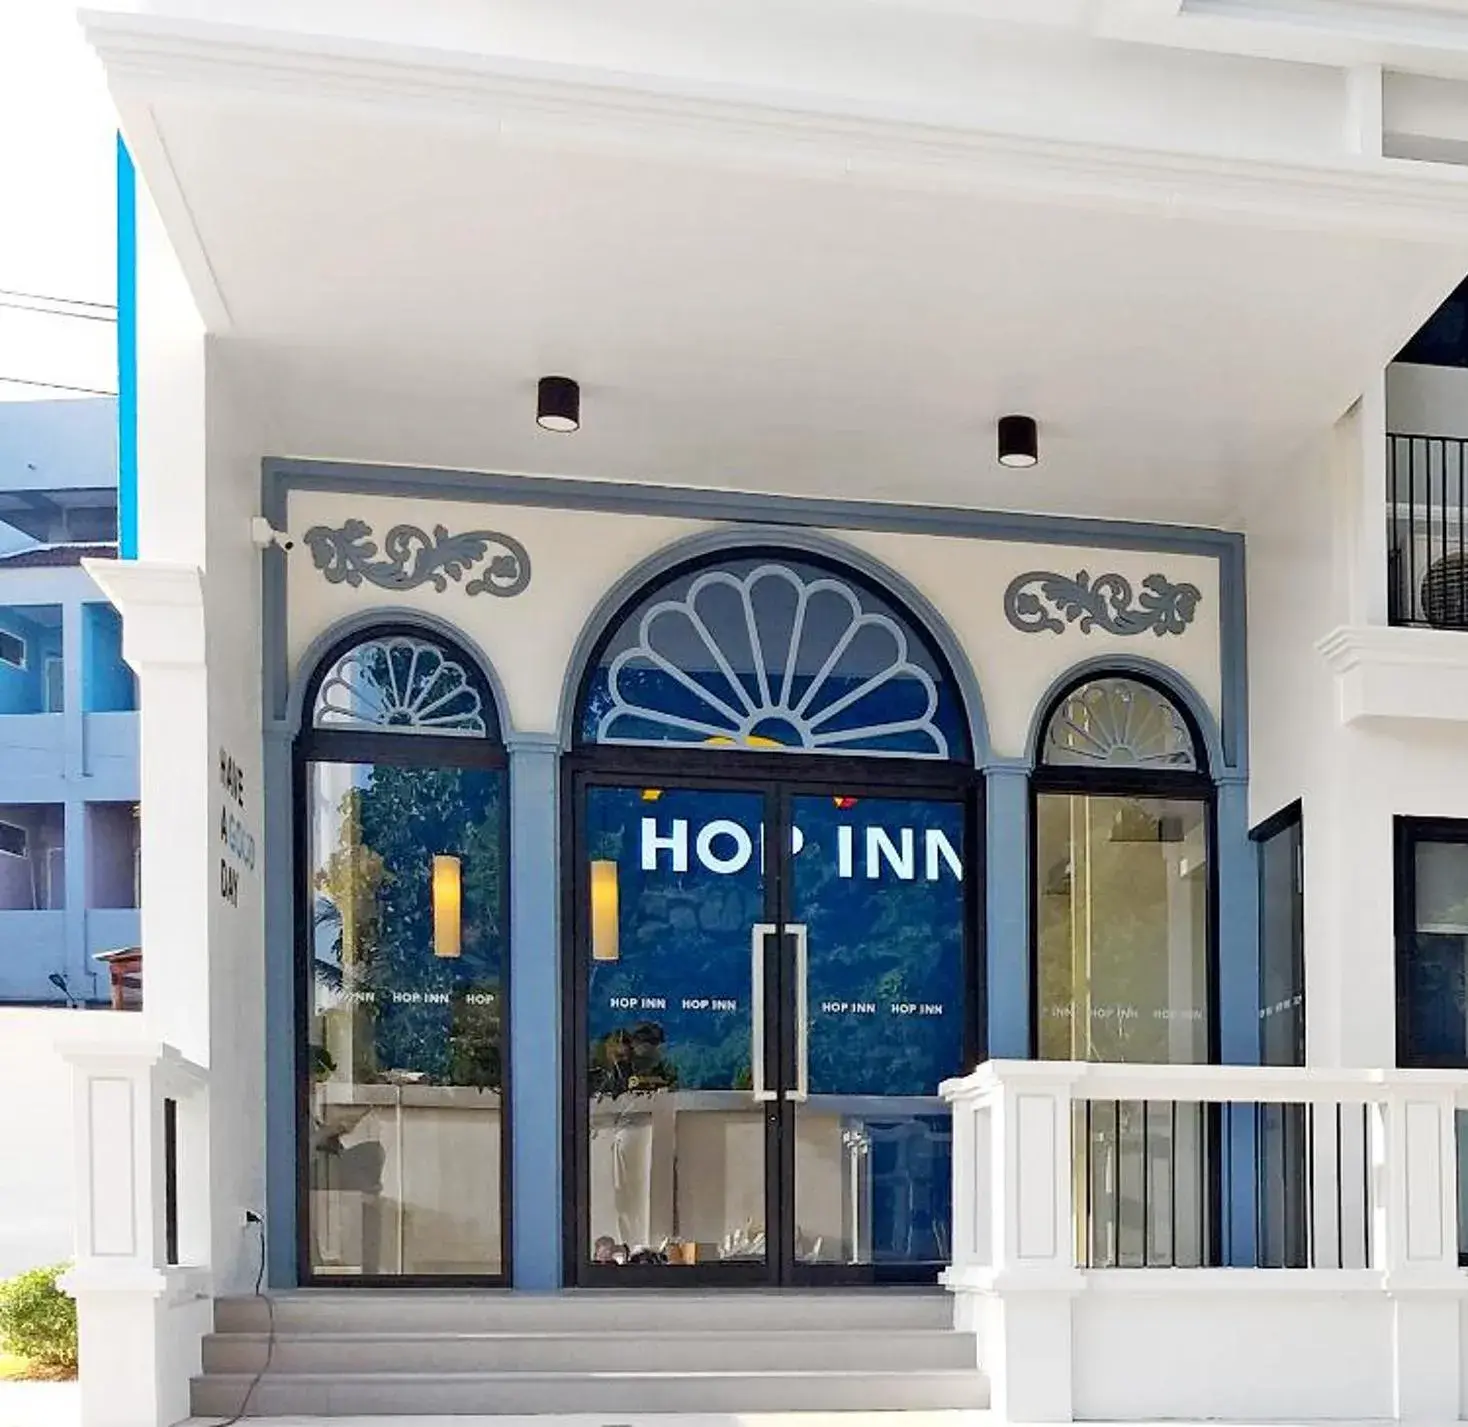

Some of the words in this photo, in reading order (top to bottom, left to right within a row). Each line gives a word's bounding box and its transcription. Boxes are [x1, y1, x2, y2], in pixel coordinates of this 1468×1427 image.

[220, 857, 239, 909] DAY
[392, 991, 421, 1004] HOP
[423, 993, 449, 1004] INN
[466, 993, 495, 1005] HOP
[610, 998, 638, 1009] HOP
[641, 998, 667, 1010] INN
[682, 999, 709, 1010] HOP
[711, 1000, 737, 1011] INN
[822, 1002, 849, 1014] HOP
[852, 1002, 876, 1014] INN
[891, 1003, 917, 1015] HOP
[919, 1004, 943, 1015] INN
